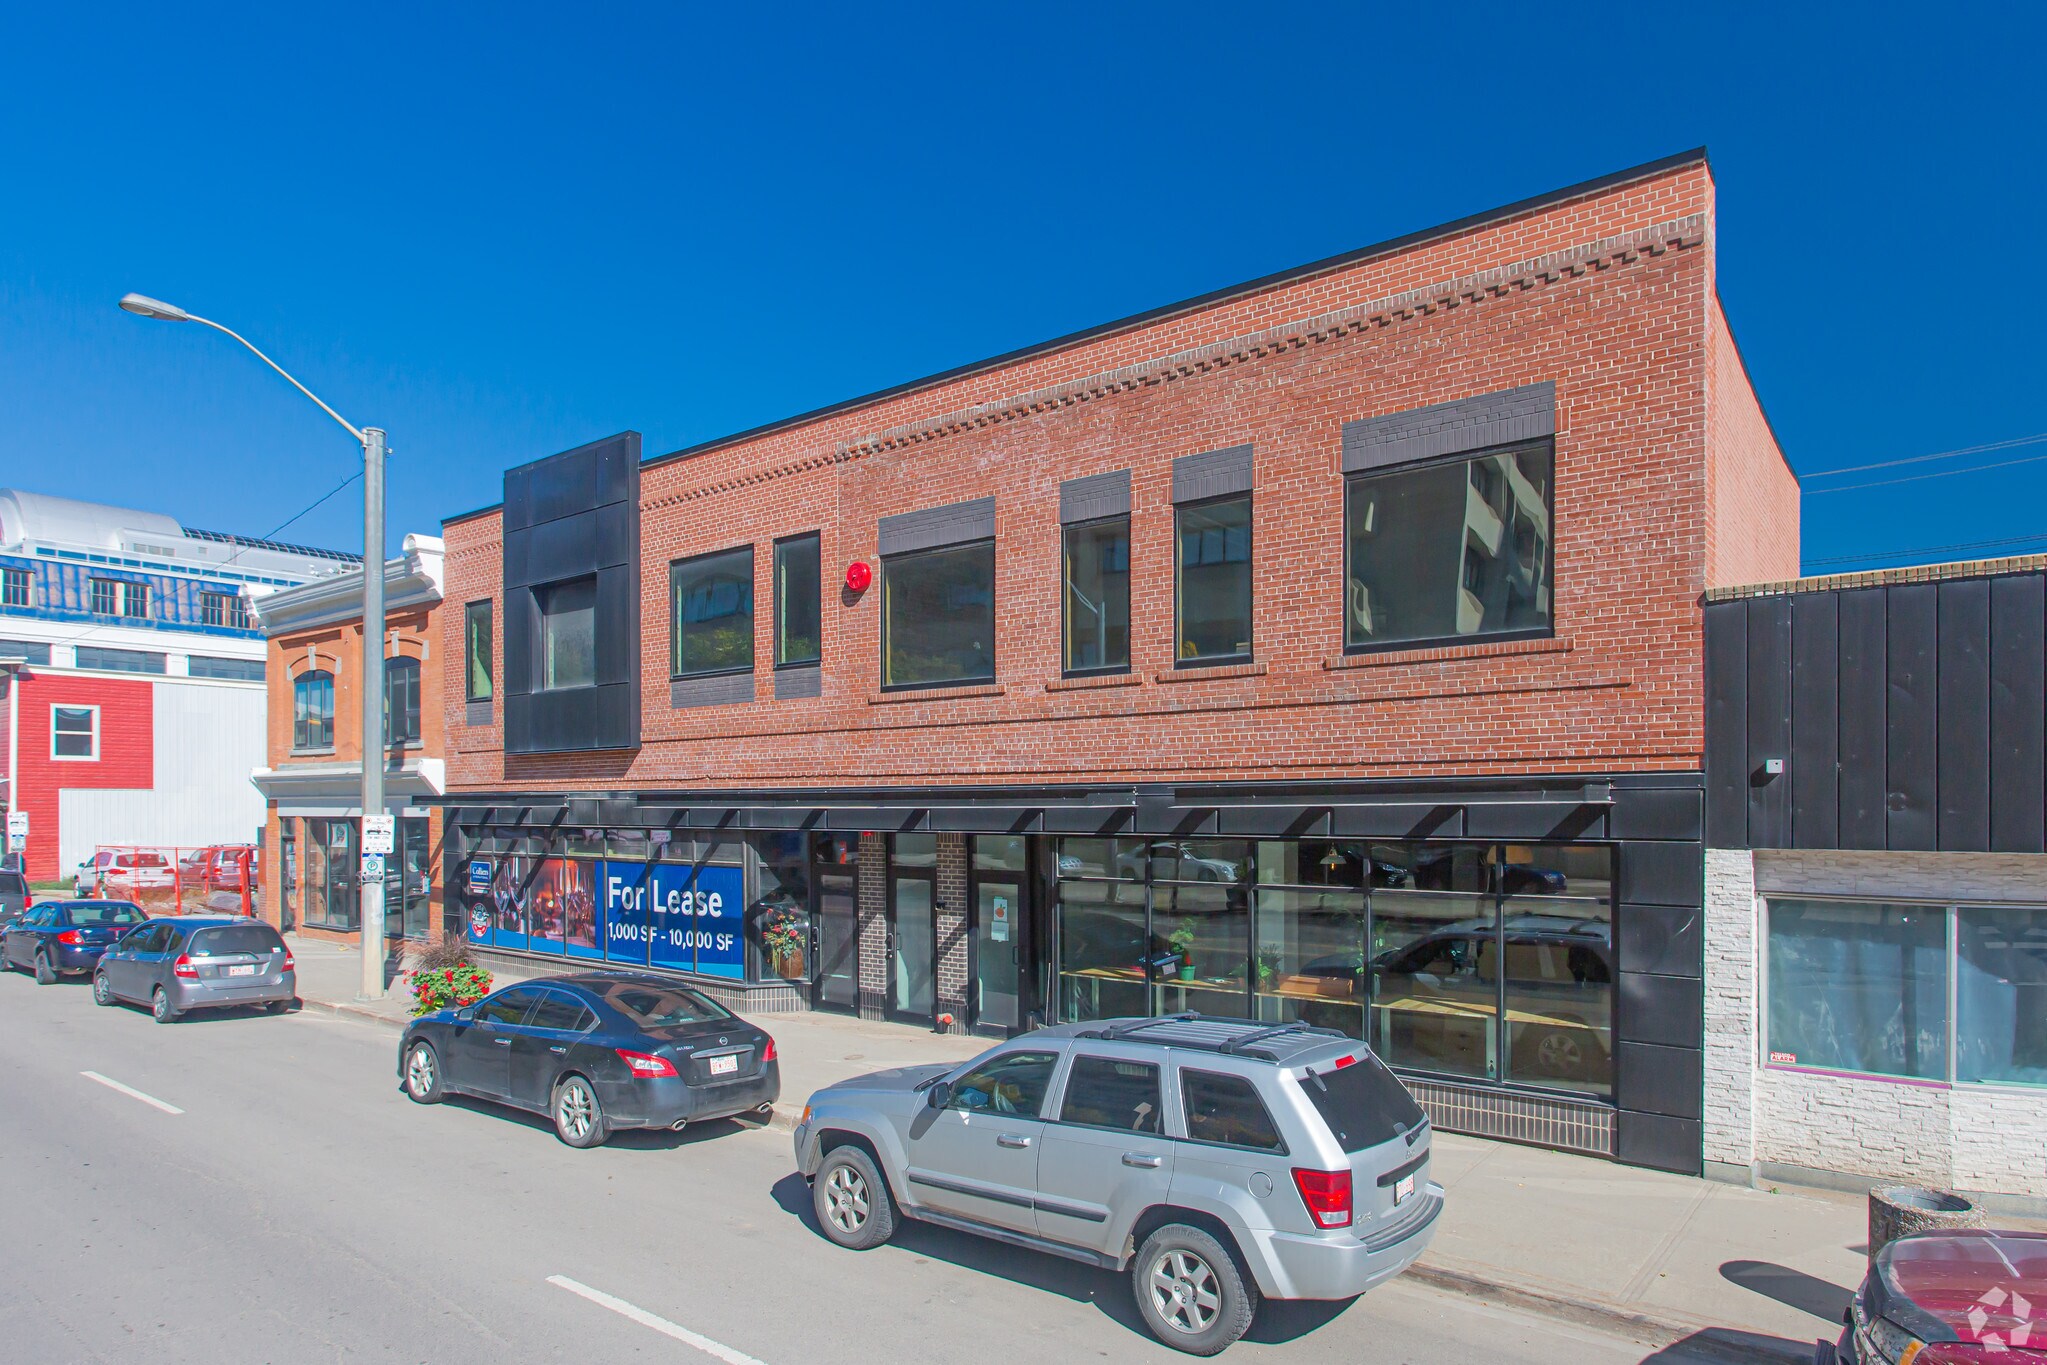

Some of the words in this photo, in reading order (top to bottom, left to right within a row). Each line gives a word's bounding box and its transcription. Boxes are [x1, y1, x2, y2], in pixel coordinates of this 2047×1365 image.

[608, 876, 645, 911] For
[653, 880, 723, 917] Lease
[608, 921, 638, 942] 1,000
[640, 924, 658, 943] SF
[669, 928, 713, 951] 10,000
[716, 932, 734, 951] SF
